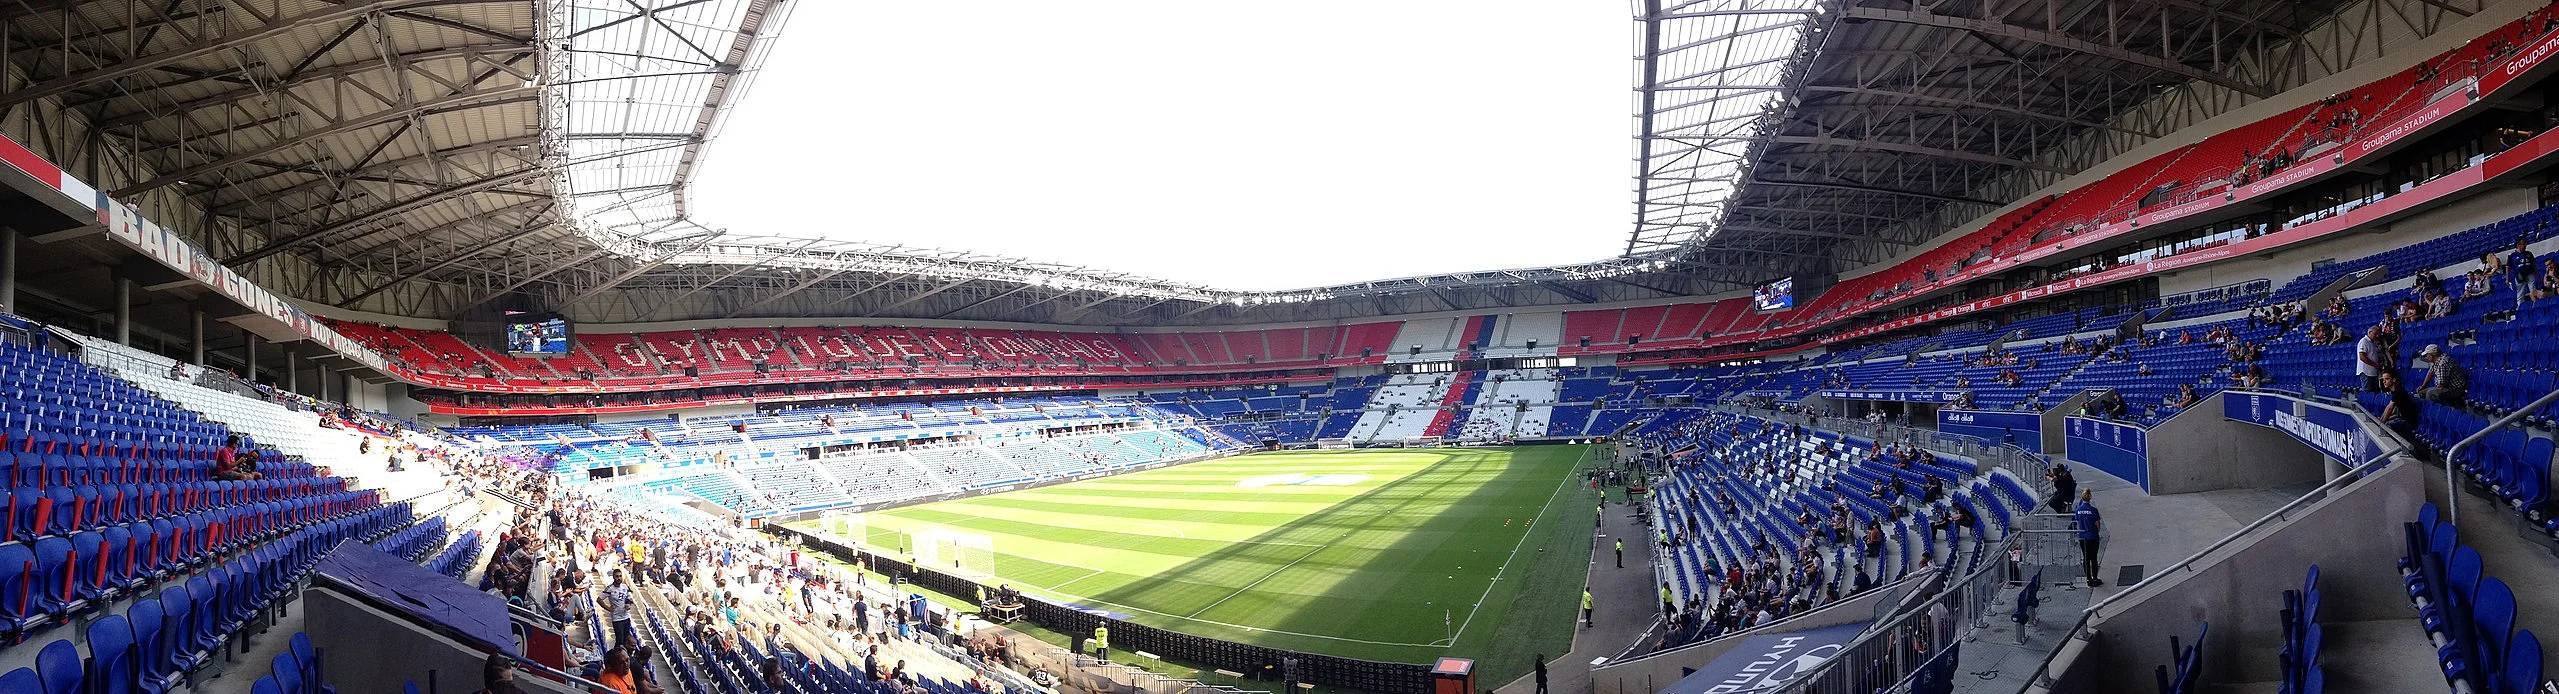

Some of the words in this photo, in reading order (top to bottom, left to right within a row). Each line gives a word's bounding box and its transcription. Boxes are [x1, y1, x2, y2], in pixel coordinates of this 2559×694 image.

[2362, 126, 2402, 151] Groupama
[2404, 107, 2440, 132] STADIUM
[2251, 177, 2285, 194] Groupama
[2286, 166, 2315, 182] STADIUM
[2151, 208, 2183, 222] Groupama
[2184, 201, 2210, 214] STADIUM
[2074, 234, 2098, 245] Groupama
[108, 197, 191, 273] BAD
[221, 264, 294, 328] GONES
[2162, 258, 2182, 269] Région
[2052, 282, 2071, 291] Microsoft
[1958, 305, 1971, 313] Orange
[310, 319, 333, 347] KOP
[614, 335, 925, 367] OLYMPIQUE
